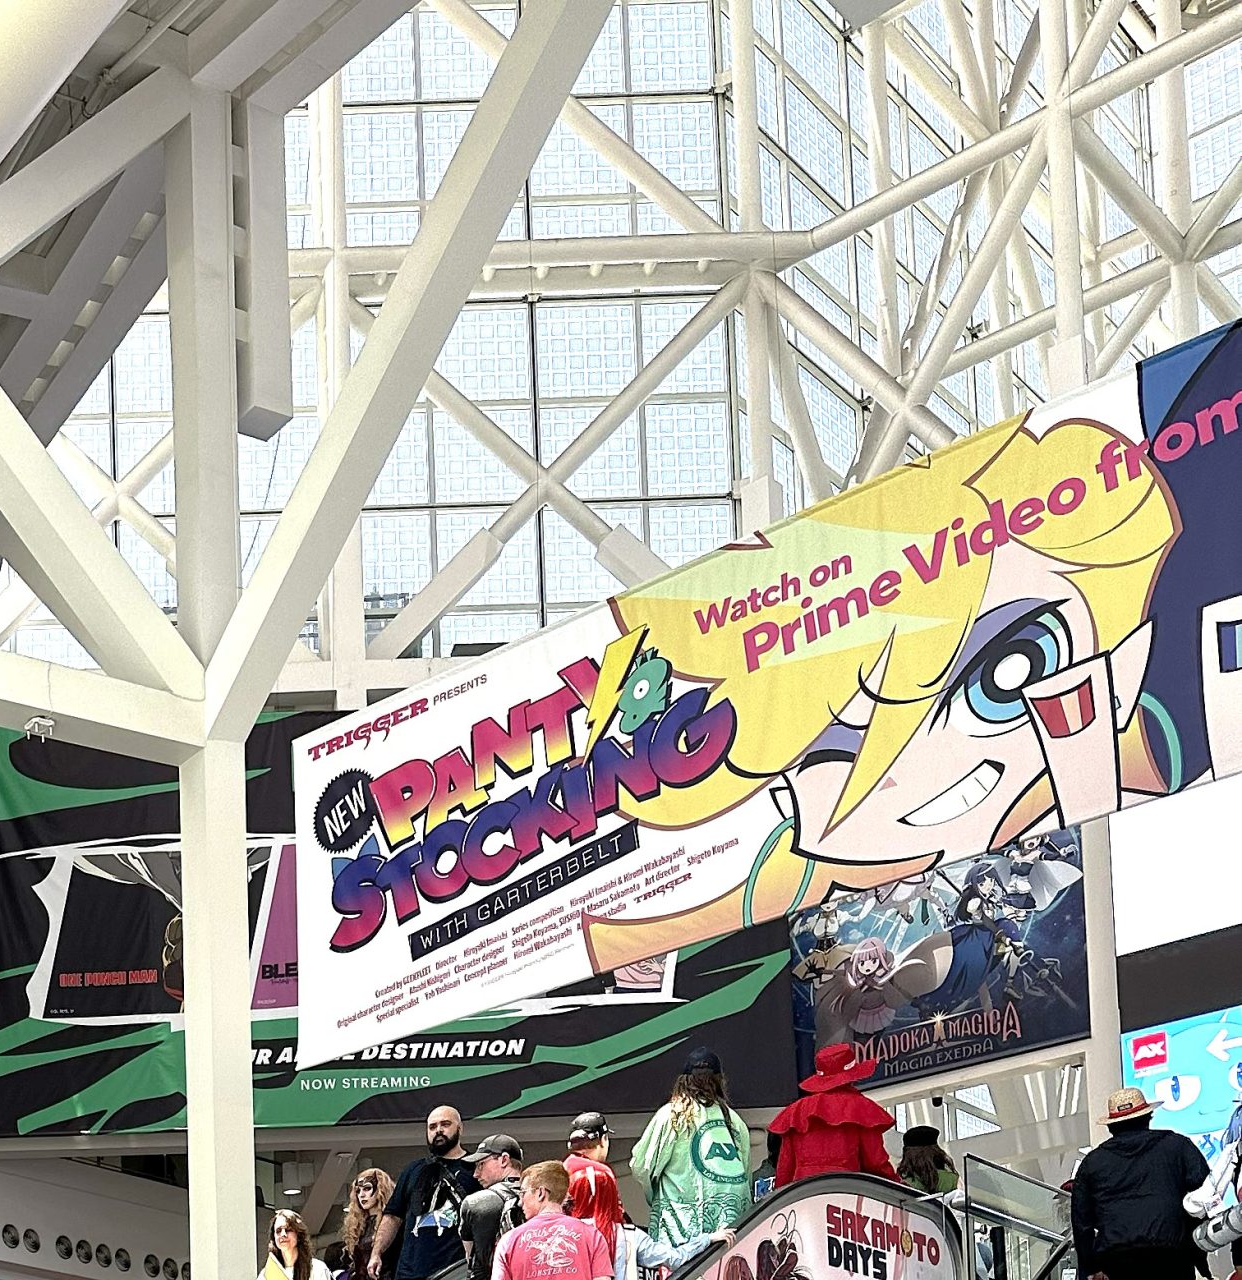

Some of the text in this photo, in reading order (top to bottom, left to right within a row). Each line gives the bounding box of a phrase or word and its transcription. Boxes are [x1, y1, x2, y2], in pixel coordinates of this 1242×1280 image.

[741, 388, 1242, 674] Prime Video from
[693, 553, 854, 636] Watch on
[308, 674, 487, 761] TRIGGER PRESENTS
[369, 656, 613, 852] PANTY
[323, 780, 366, 844] NEW
[331, 688, 738, 953] STOCKING
[420, 912, 469, 949] WITH
[477, 834, 622, 921] GARTERBELT
[633, 872, 693, 905] TRIGGER
[337, 1012, 358, 1029] Original
[357, 1001, 381, 1020] character
[382, 992, 404, 1009] designer
[427, 970, 451, 989] Nishigori
[454, 956, 481, 974] Character
[481, 945, 505, 963] designer
[511, 932, 533, 949] Shigeto
[586, 897, 610, 914] Masaru
[610, 883, 641, 903] Sakamoto
[644, 875, 656, 888] Art
[655, 864, 681, 882] director
[687, 849, 712, 867] Shigeto
[712, 837, 740, 856] Koyama
[375, 979, 398, 999] Created
[435, 955, 458, 971] Director
[463, 940, 486, 958] Hiroyuki
[486, 930, 508, 945] Imaishi
[511, 922, 529, 936] Series
[529, 905, 565, 927] composition
[570, 888, 595, 909] Hiroyuki
[595, 880, 617, 897] Imaishi
[623, 866, 644, 884] Hiromi
[644, 845, 686, 873] Wakabayashi
[59, 969, 158, 987] ONE PUNCH MAN
[376, 1006, 396, 1024] Special
[395, 996, 420, 1016] specialist
[464, 966, 487, 984] Concept
[487, 956, 508, 975] planner
[513, 944, 533, 960] Hiromi
[533, 926, 573, 952] Wakabayashi
[361, 1038, 526, 1061] DESTINATION
[853, 1000, 1022, 1064] MADOKA MAGICA
[884, 1038, 993, 1077] MAGIA EXEDRA
[1133, 1041, 1166, 1062] AX
[300, 1076, 431, 1091] NOW STREAMING
[705, 1141, 742, 1161] AX
[826, 1203, 941, 1266] SAKAMOTO
[827, 1235, 887, 1280] DAYS
[526, 1266, 578, 1280] LOBSTER CO
